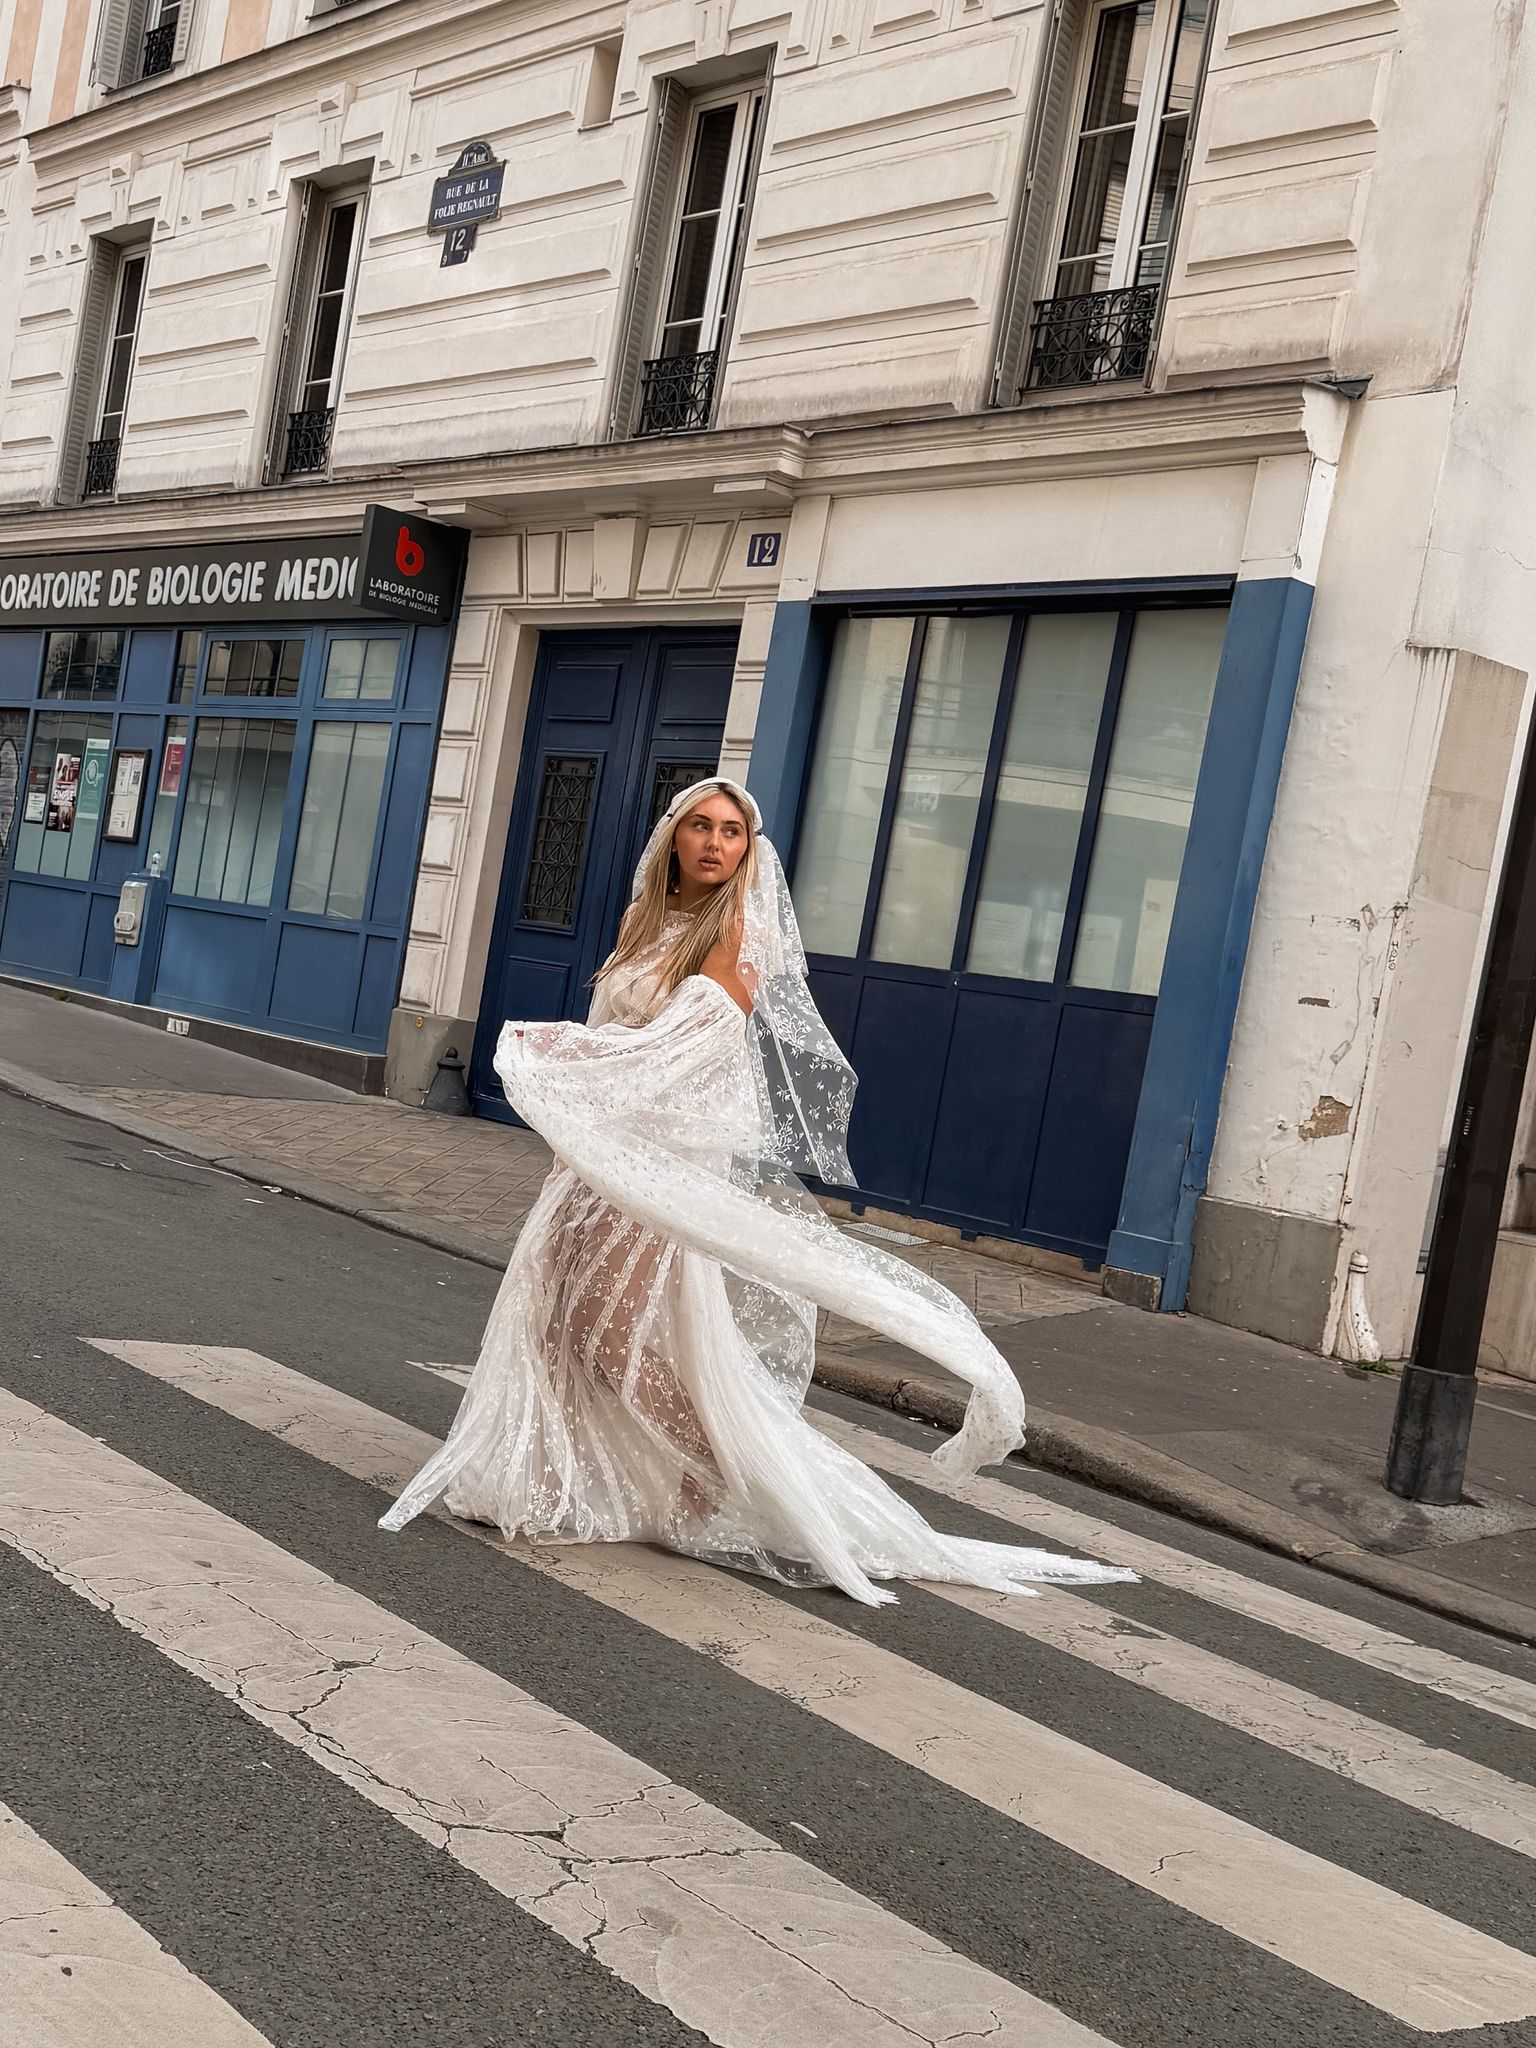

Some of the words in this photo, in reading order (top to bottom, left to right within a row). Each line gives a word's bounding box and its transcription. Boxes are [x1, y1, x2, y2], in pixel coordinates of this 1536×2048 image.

[445, 185, 463, 200] RUE
[465, 181, 477, 195] DE
[478, 178, 489, 192] LA
[433, 204, 457, 220] FOLIE
[457, 193, 497, 213] REGNAULT
[450, 228, 467, 252] 12
[752, 536, 776, 564] 12
[0, 570, 103, 610] ORATOIRE
[108, 568, 140, 607] DE
[147, 560, 267, 605] BIOLOGIE
[370, 577, 440, 606] LABORATOIRE
